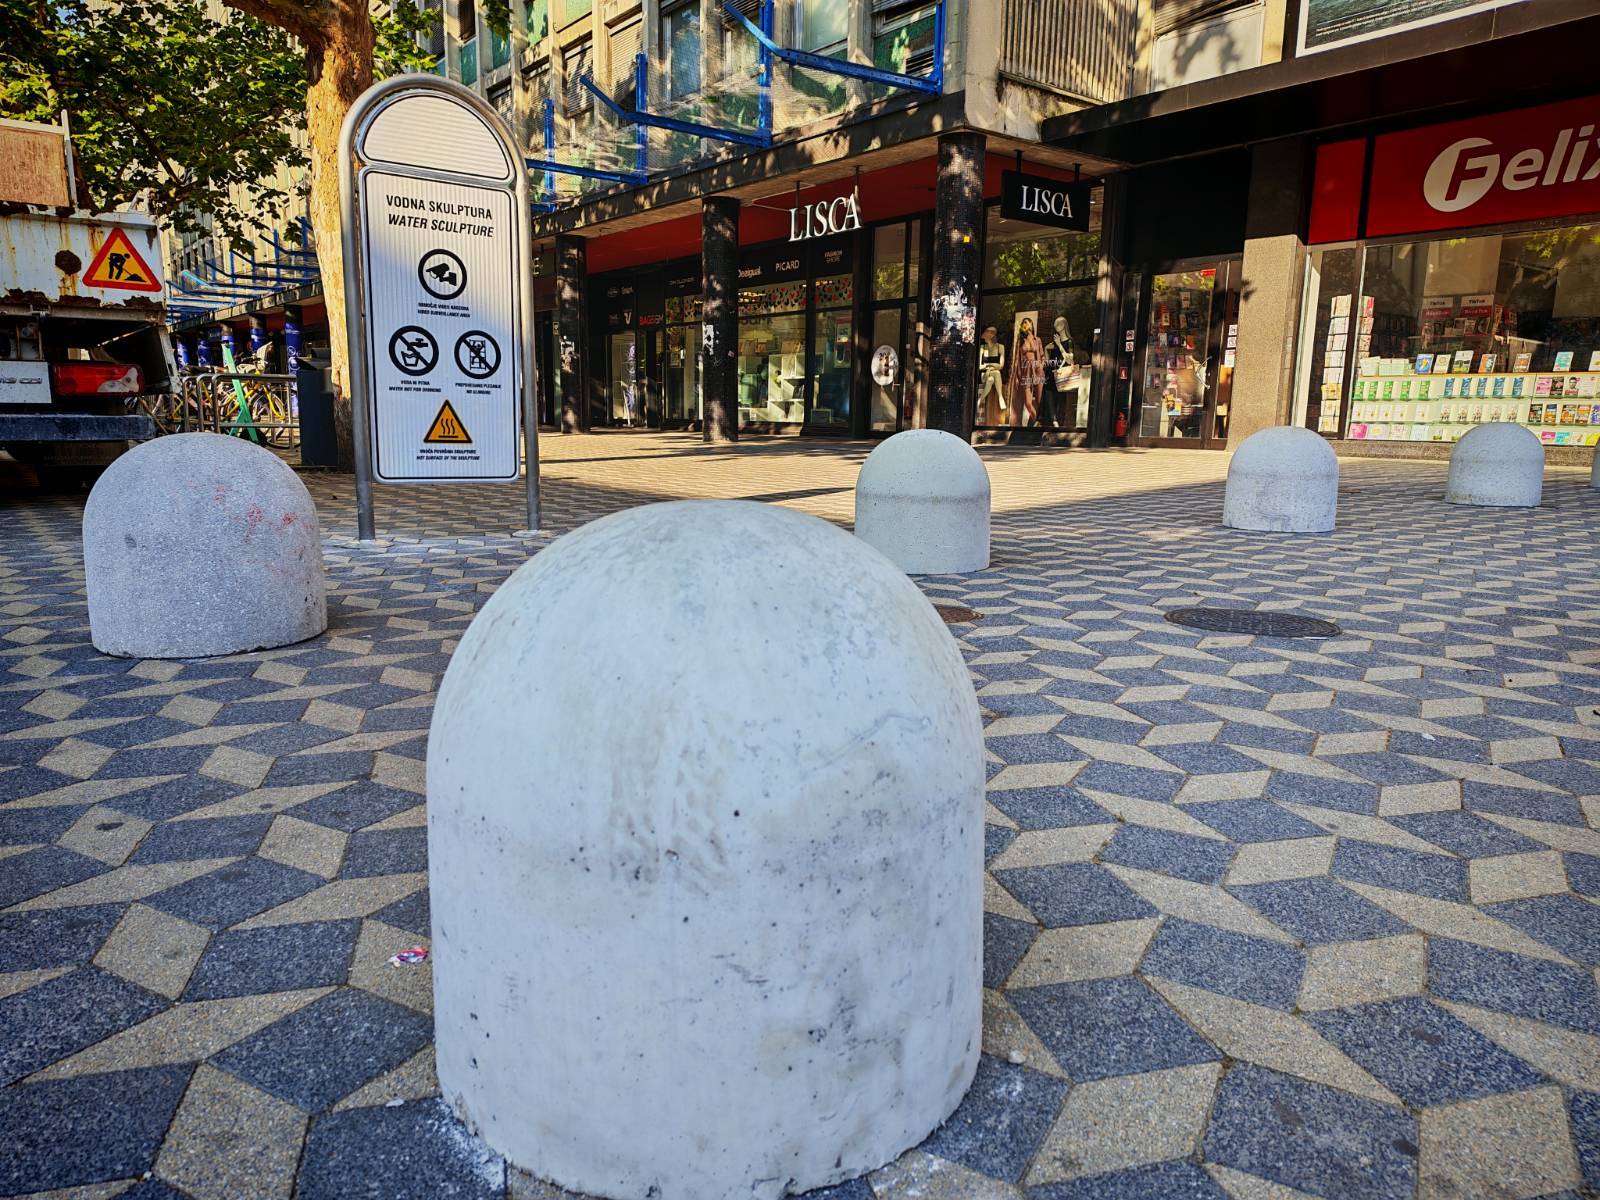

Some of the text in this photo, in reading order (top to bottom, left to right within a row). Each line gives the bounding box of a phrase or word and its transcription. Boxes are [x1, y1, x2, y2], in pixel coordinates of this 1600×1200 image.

[386, 195, 493, 220] VODNA SKULPTURA
[1020, 185, 1075, 219] LISCA
[388, 213, 494, 238] WATER SCULPTURE
[788, 192, 863, 242] LISCA
[775, 259, 801, 272] PICARD
